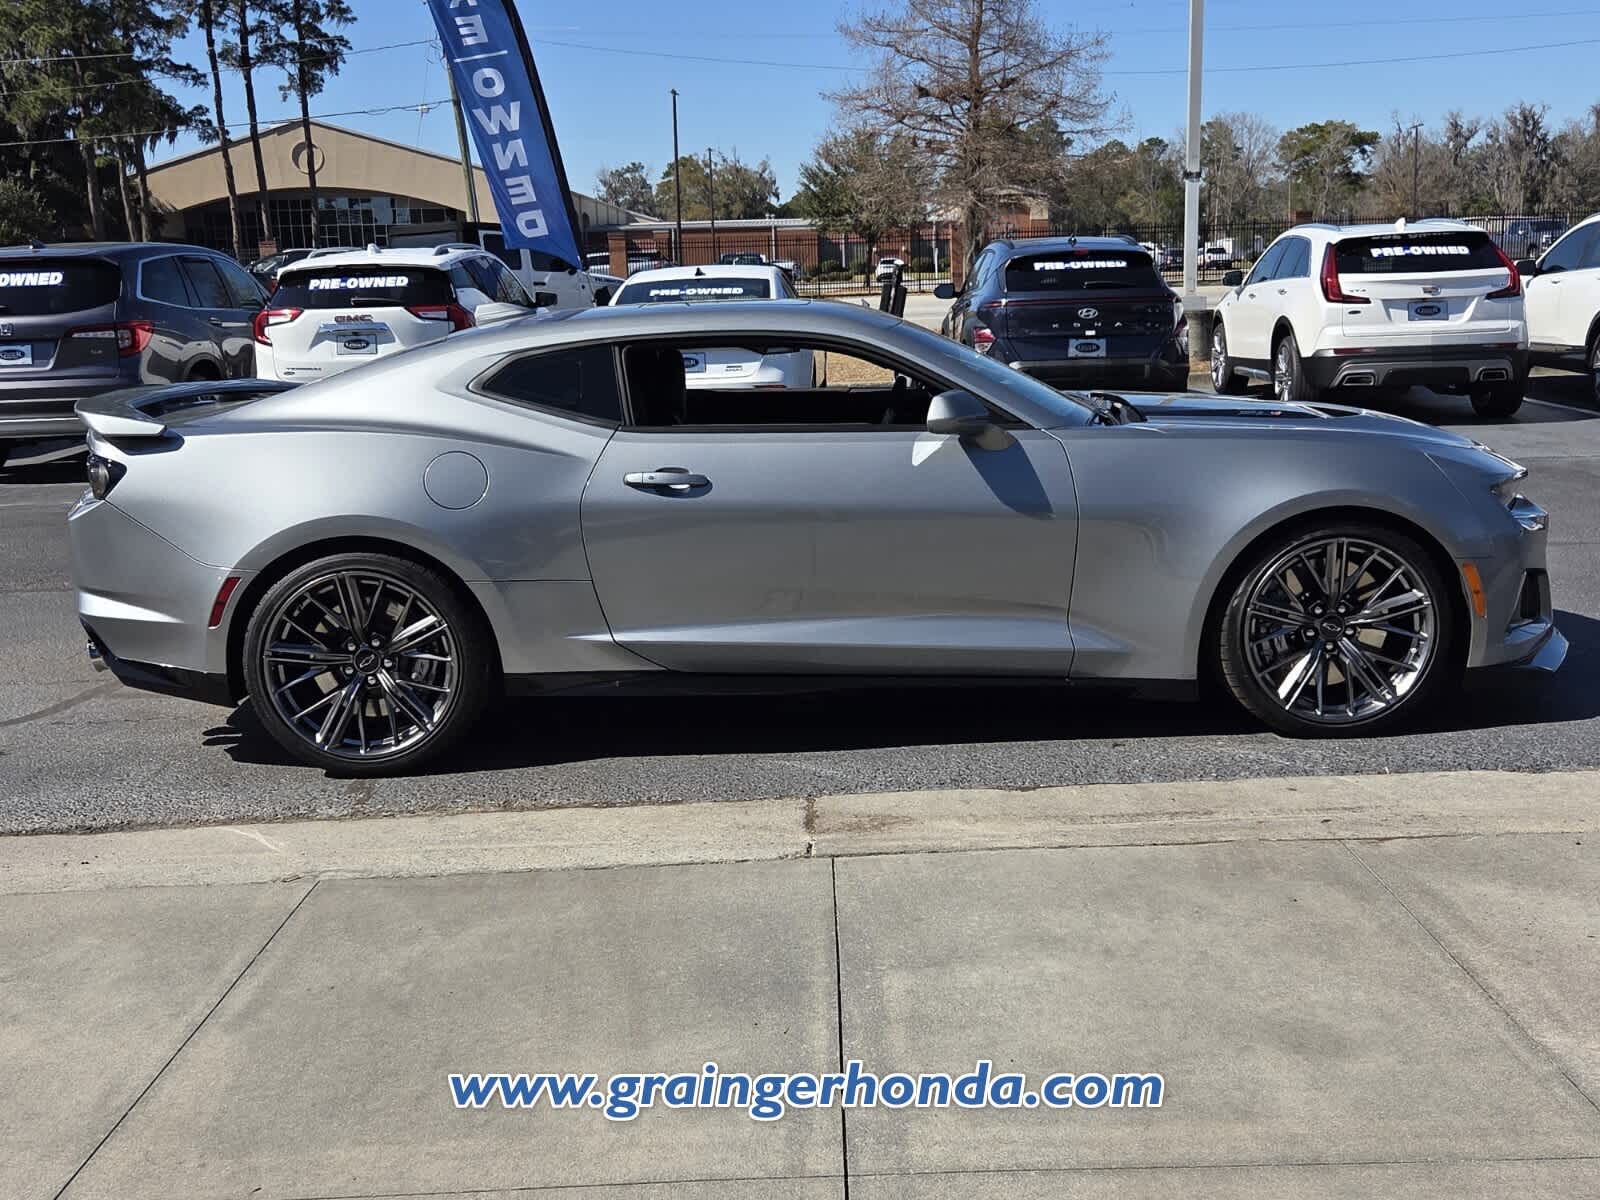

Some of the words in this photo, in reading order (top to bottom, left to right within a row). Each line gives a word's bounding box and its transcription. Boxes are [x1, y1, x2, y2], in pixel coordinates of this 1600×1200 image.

[1370, 245, 1471, 258] PRE-OWNED
[1033, 260, 1128, 271] PRE-OWNED
[308, 276, 409, 291] PRE-OWNED
[649, 287, 744, 297] PRE-OWNED
